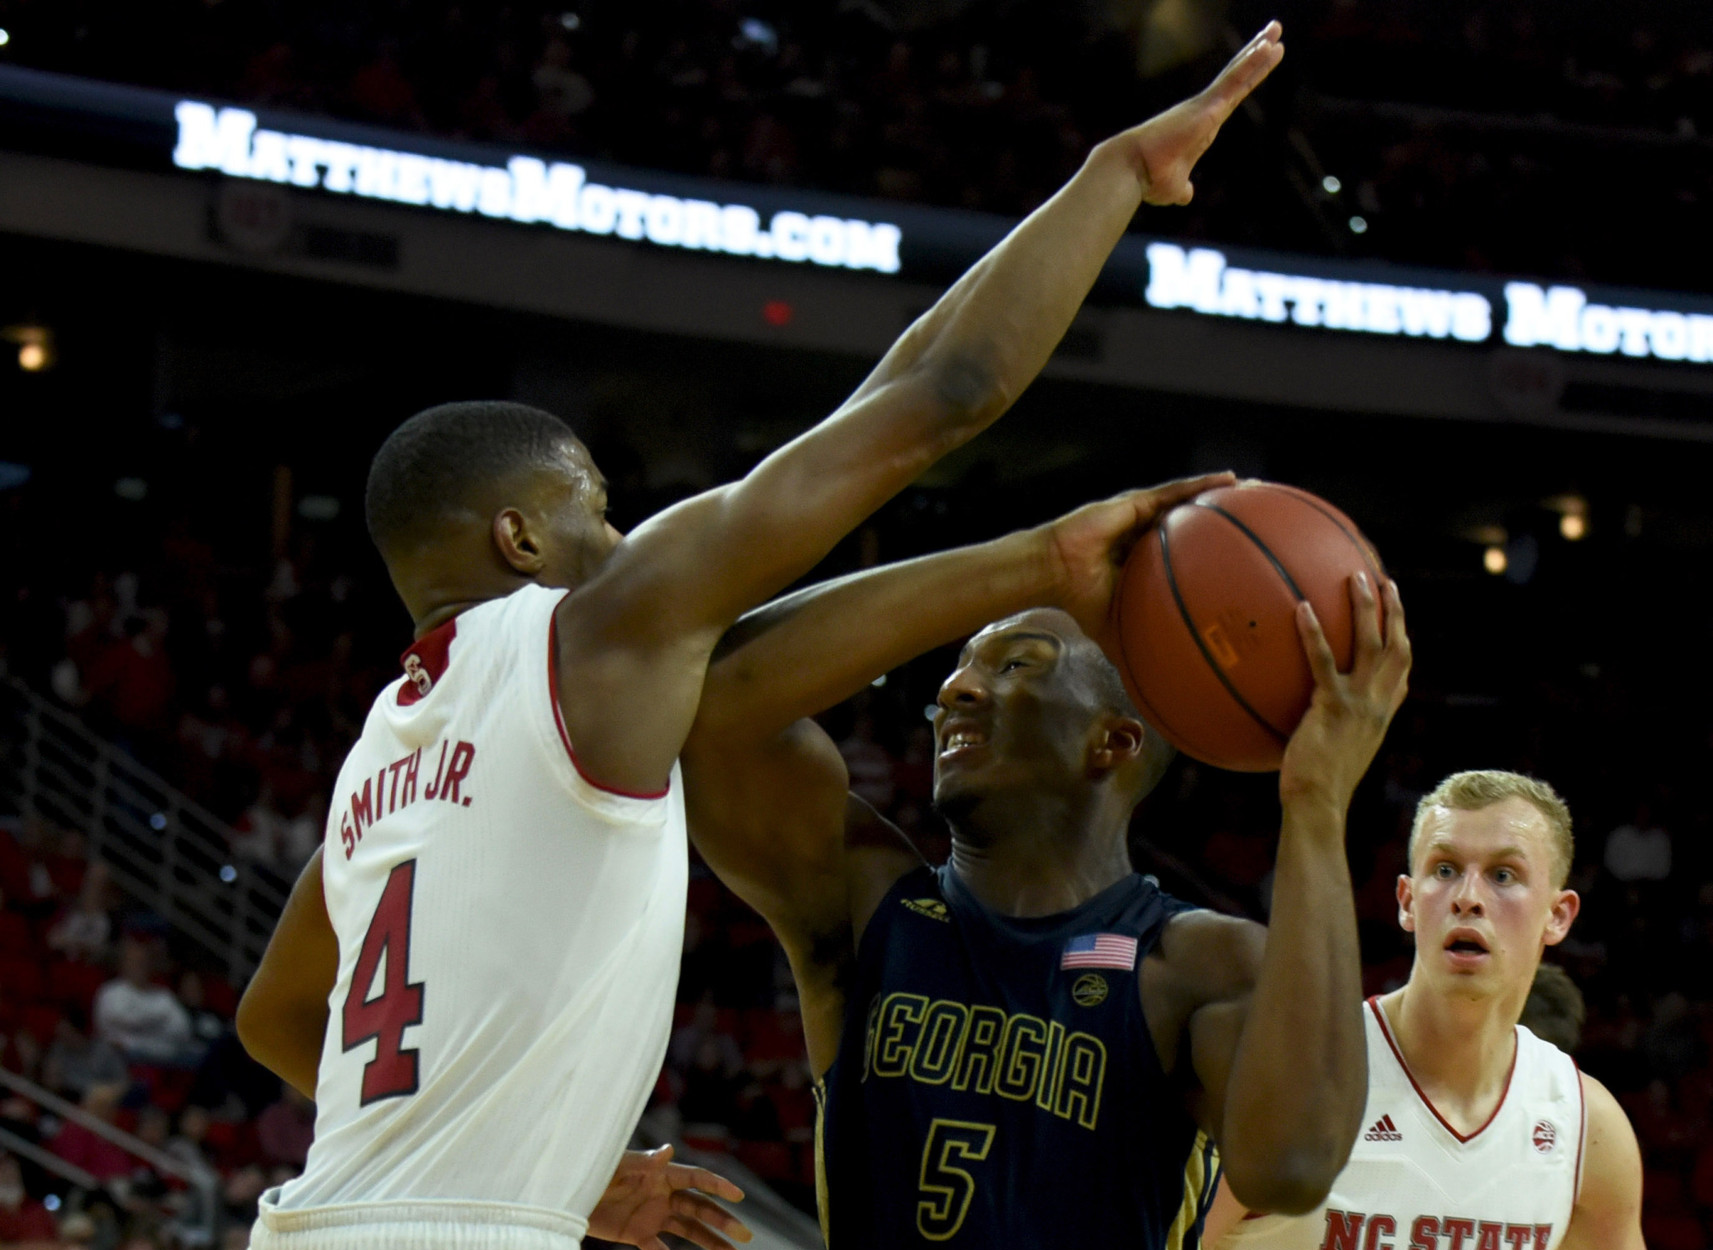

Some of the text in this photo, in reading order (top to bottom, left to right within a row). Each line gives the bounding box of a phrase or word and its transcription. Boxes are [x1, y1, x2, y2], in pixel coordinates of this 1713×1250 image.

[341, 740, 475, 861] SMITH JR.
[342, 858, 425, 1107] 4
[917, 1118, 996, 1242] 5
[1364, 1131, 1403, 1142] adidas
